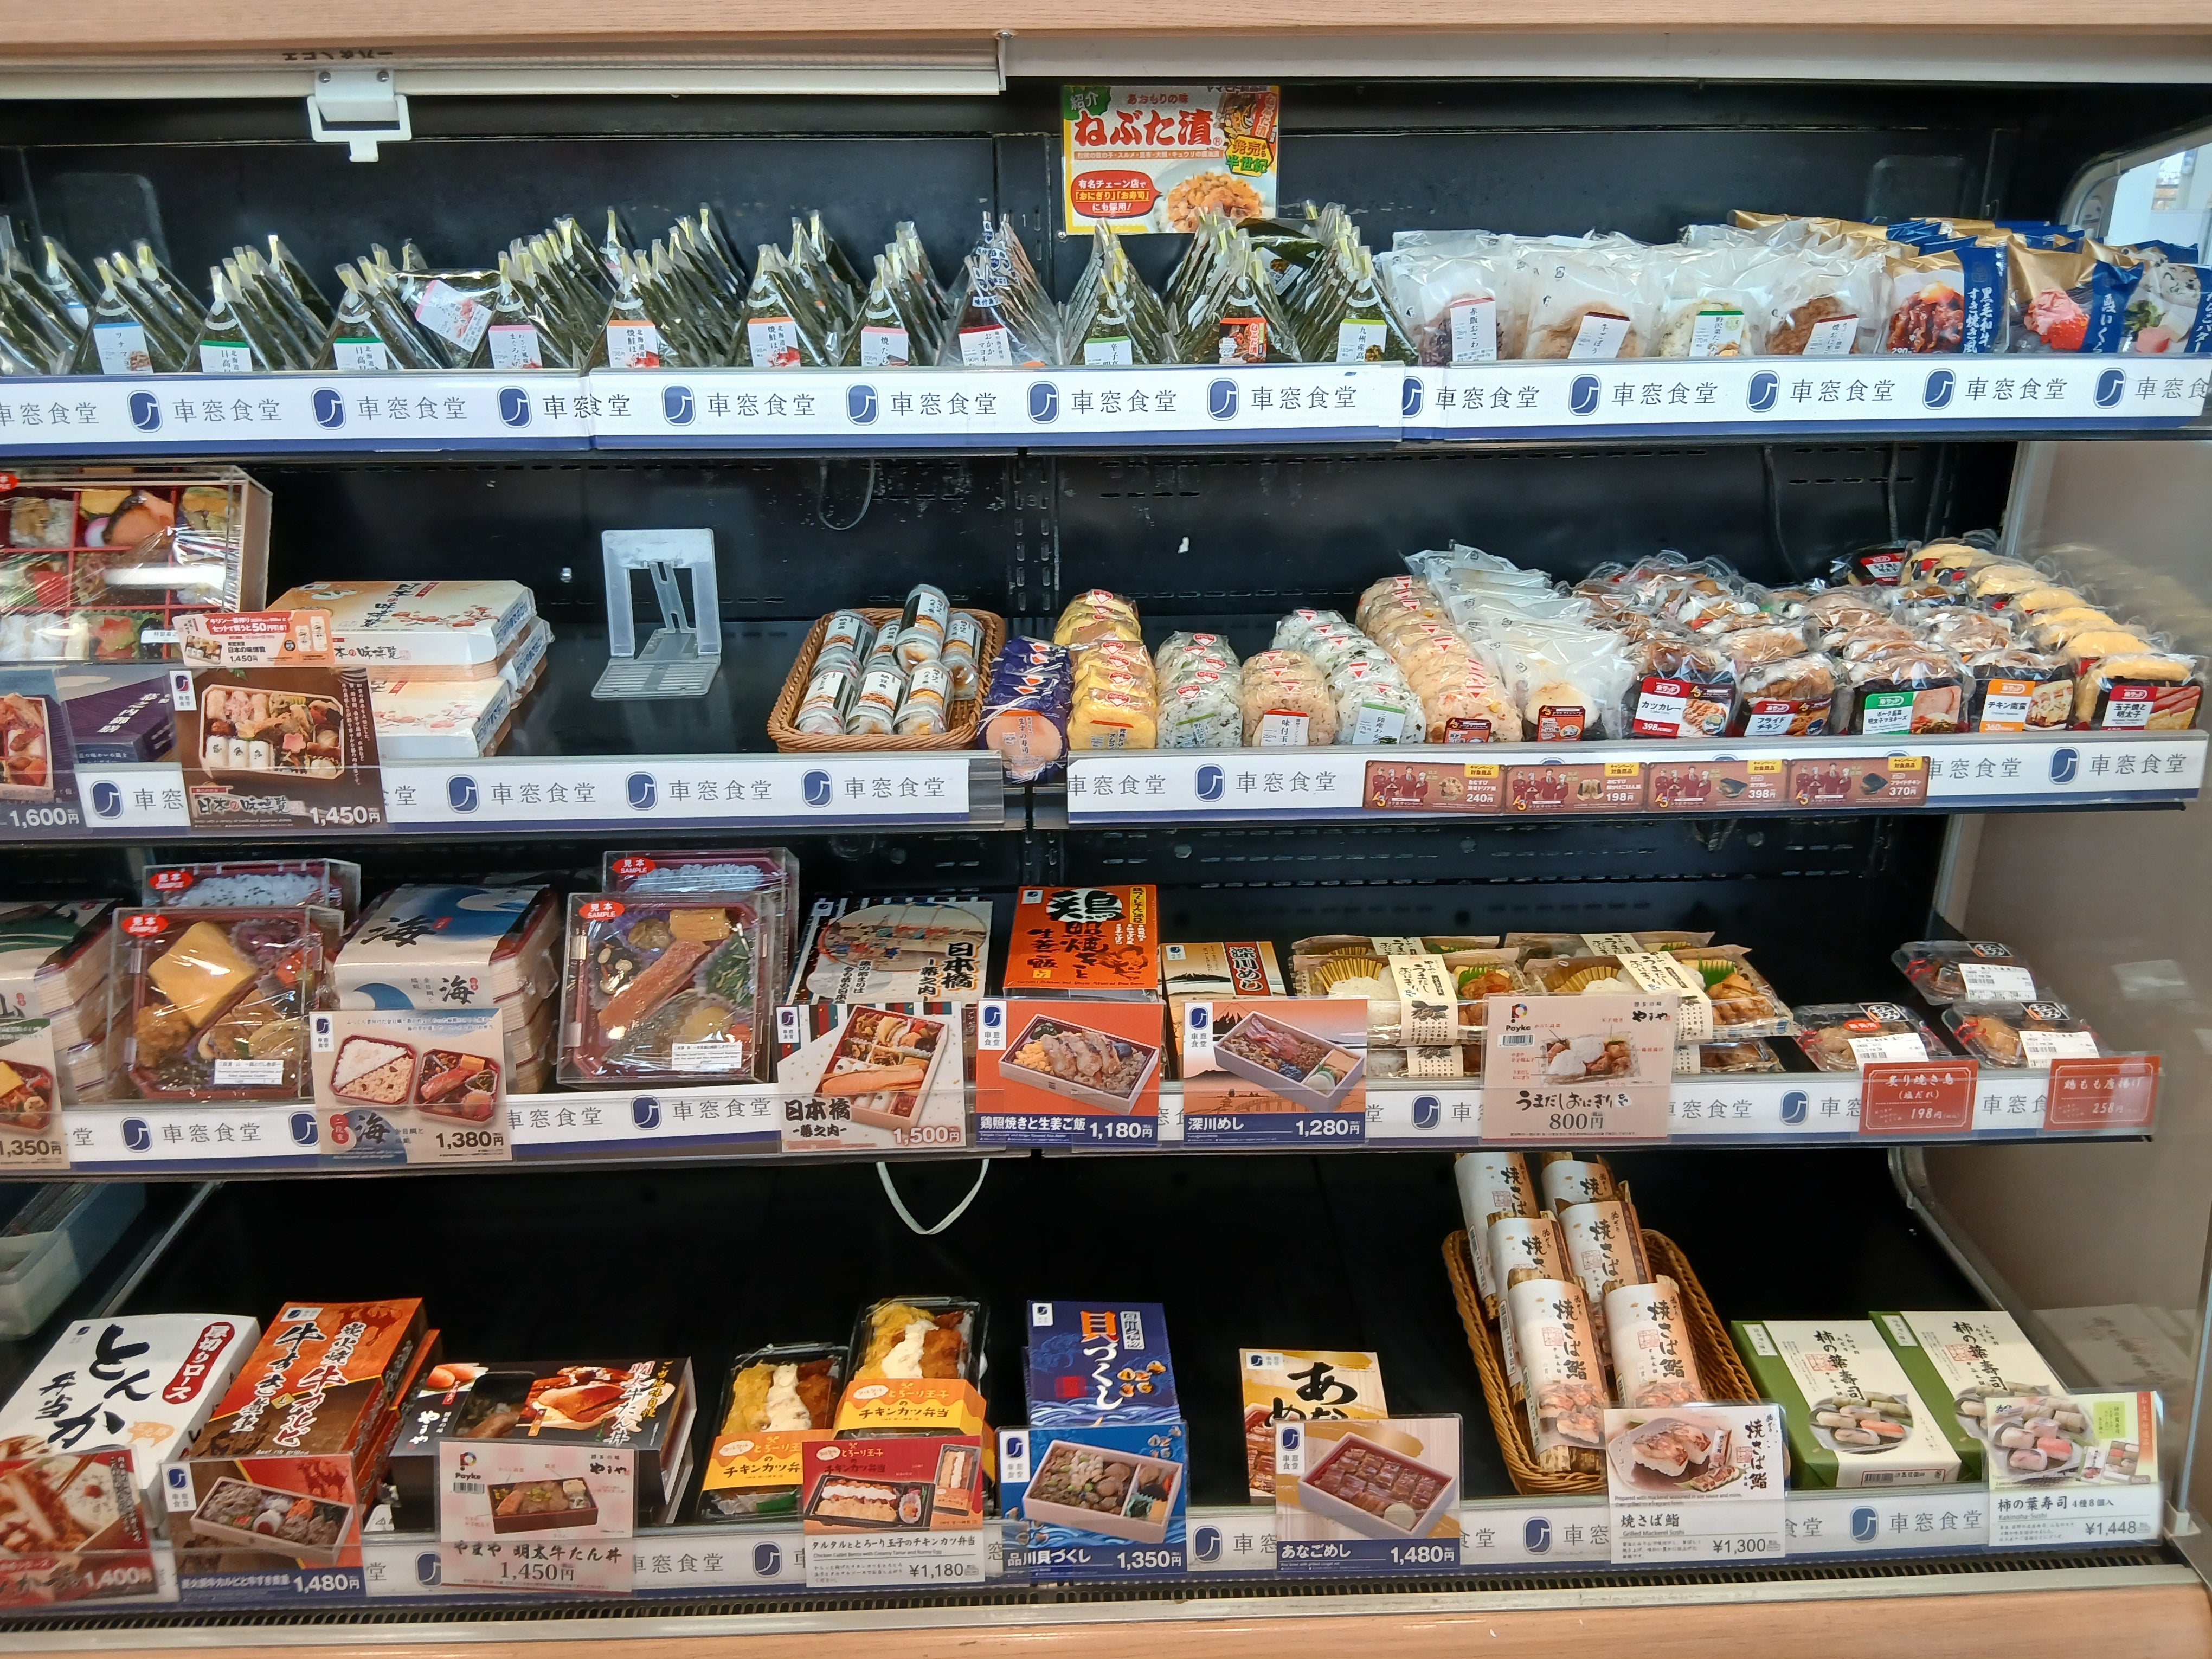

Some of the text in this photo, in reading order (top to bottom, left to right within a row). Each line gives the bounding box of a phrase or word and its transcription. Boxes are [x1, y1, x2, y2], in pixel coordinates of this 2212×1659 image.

[1070, 91, 1099, 110] 紹介
[1127, 93, 1189, 105] あおもりの味
[1074, 109, 1213, 146] ねぶた漬
[1225, 155, 1269, 174] 半世紀
[1078, 179, 1146, 189] 有名チェーン店で
[1075, 191, 1150, 201] 「おにぎり」「お寿司」
[1963, 288, 1980, 353] すき焼き風
[1979, 287, 1994, 345] 黒毛和牛
[1468, 307, 1480, 348] 赤飯おこわ
[115, 331, 131, 367] ツナマヨ
[880, 336, 890, 365] 焼たら
[986, 333, 995, 356] おかか
[1591, 324, 1609, 355] 牛ごぼう
[232, 349, 241, 371] 北海道
[366, 346, 375, 368] 北海道
[1251, 385, 1358, 410] 車窓食堂
[1435, 384, 1540, 410] 車窓食堂
[1611, 381, 1718, 407] 車窓食堂
[1789, 377, 1896, 402] 車窓食堂
[1964, 376, 2069, 401] 車窓食堂
[2134, 375, 2207, 400] 車窓食
[172, 397, 282, 423] 車窓食堂
[357, 395, 468, 420] 車窓食堂
[708, 393, 815, 417] 車窓食堂
[891, 390, 997, 415] 車窓食堂
[1071, 388, 1176, 414] 車窓食堂
[0, 401, 100, 427] 車窓食堂
[360, 583, 419, 628] 日本の味博覧
[1641, 701, 1681, 711] カツカレー
[1988, 700, 2028, 710] チキン南蛮
[2116, 710, 2141, 719] 明太子
[1018, 717, 1029, 754] ますの寿司
[2089, 753, 2187, 776] 車窓食堂
[669, 779, 773, 802] 車窓食堂
[844, 776, 946, 799] 車窓食堂
[1067, 773, 1166, 797] 車窓食堂
[1236, 770, 1336, 793] 車窓食堂
[1888, 786, 1917, 797] 370円
[133, 788, 184, 811] 車窓
[491, 782, 596, 805] 車窓食堂
[1466, 793, 1494, 803] 240円
[1606, 792, 1634, 802] 198円
[1748, 789, 1776, 799] 398円
[197, 796, 292, 815] 日本の味博覧
[309, 806, 381, 826] 1,450円
[9, 808, 80, 828] 1,600円
[623, 859, 645, 867] 見本
[155, 881, 185, 889] SAMPLE
[157, 873, 182, 883] 見本
[587, 910, 616, 918] SAMPLE
[590, 901, 614, 911] 見本
[128, 925, 158, 934] SAMPLE
[130, 916, 157, 926] 見本
[360, 914, 437, 948] 海
[941, 942, 976, 989] 日本橋
[1229, 947, 1264, 992] 深川めし
[439, 975, 478, 1005] 海
[1506, 1024, 1531, 1032] Payke
[1885, 1072, 1954, 1087] 炙り焼き鳥
[672, 1098, 772, 1121] 車窓食堂
[785, 1098, 851, 1121] 日本橋
[1516, 1090, 1613, 1110] うまだしおにぎり
[507, 1105, 603, 1129] 車窓食堂
[980, 1115, 1086, 1131] 鶏照焼きと生姜ご飯
[1187, 1117, 1245, 1131] 深川めし
[1549, 1112, 1604, 1129] 800円
[1911, 1107, 1942, 1120] 198円
[161, 1121, 262, 1144] 車窓食堂
[355, 1112, 391, 1144] 海
[893, 1126, 960, 1146] 1,500円
[1089, 1122, 1153, 1140] 1,180円
[1296, 1118, 1360, 1136] 1,280円
[435, 1130, 504, 1150] 1,380円
[1122, 1312, 1144, 1349] 品川名物
[1552, 1298, 1587, 1380] 焼さば鮨
[1647, 1301, 1685, 1379] 焼さば鮨
[165, 1324, 232, 1400] 厚切りロース
[1080, 1310, 1123, 1410] 貝づくし
[34, 1370, 77, 1420] 弁当
[273, 1322, 367, 1447] 炭火焼牛カルビ
[641, 1360, 674, 1419] ご当地味自慢
[888, 1388, 949, 1399] とろーり王子
[603, 1361, 657, 1447] 明太牛たん丼
[858, 1407, 949, 1419] チキンカツ弁当
[409, 1410, 440, 1445] やまや
[753, 1441, 802, 1454] とろーり王
[841, 1448, 883, 1458] とろーり王子
[1745, 1418, 1767, 1490] 焼さば鮨
[455, 1472, 481, 1480] Payke
[723, 1463, 802, 1478] チキンカツ弁
[1997, 1495, 2068, 1513] 柿の葉寿司
[1621, 1513, 1680, 1528] 焼さば鮨
[1888, 1509, 1983, 1534] 車窓食堂
[2085, 1520, 2137, 1536] ¥1,448
[812, 1535, 975, 1551] タルタルととろーり王子のチキンカツ弁当
[1233, 1532, 1277, 1555] 車窓
[1564, 1523, 1610, 1546] 車窓
[453, 1540, 622, 1564] やまや 明太牛たん丼
[1007, 1548, 1092, 1567] 品川貝づくし
[1281, 1543, 1352, 1559] あなごめし
[1390, 1545, 1455, 1564] 1,480円
[1713, 1538, 1766, 1555] ¥1,300
[909, 1562, 964, 1579] ¥1,180
[1117, 1550, 1182, 1569] 1,350円
[83, 1566, 152, 1590] 1,400円
[367, 1561, 388, 1583] 堂
[500, 1562, 575, 1581] 1,450円
[293, 1574, 361, 1594] 1,480円
